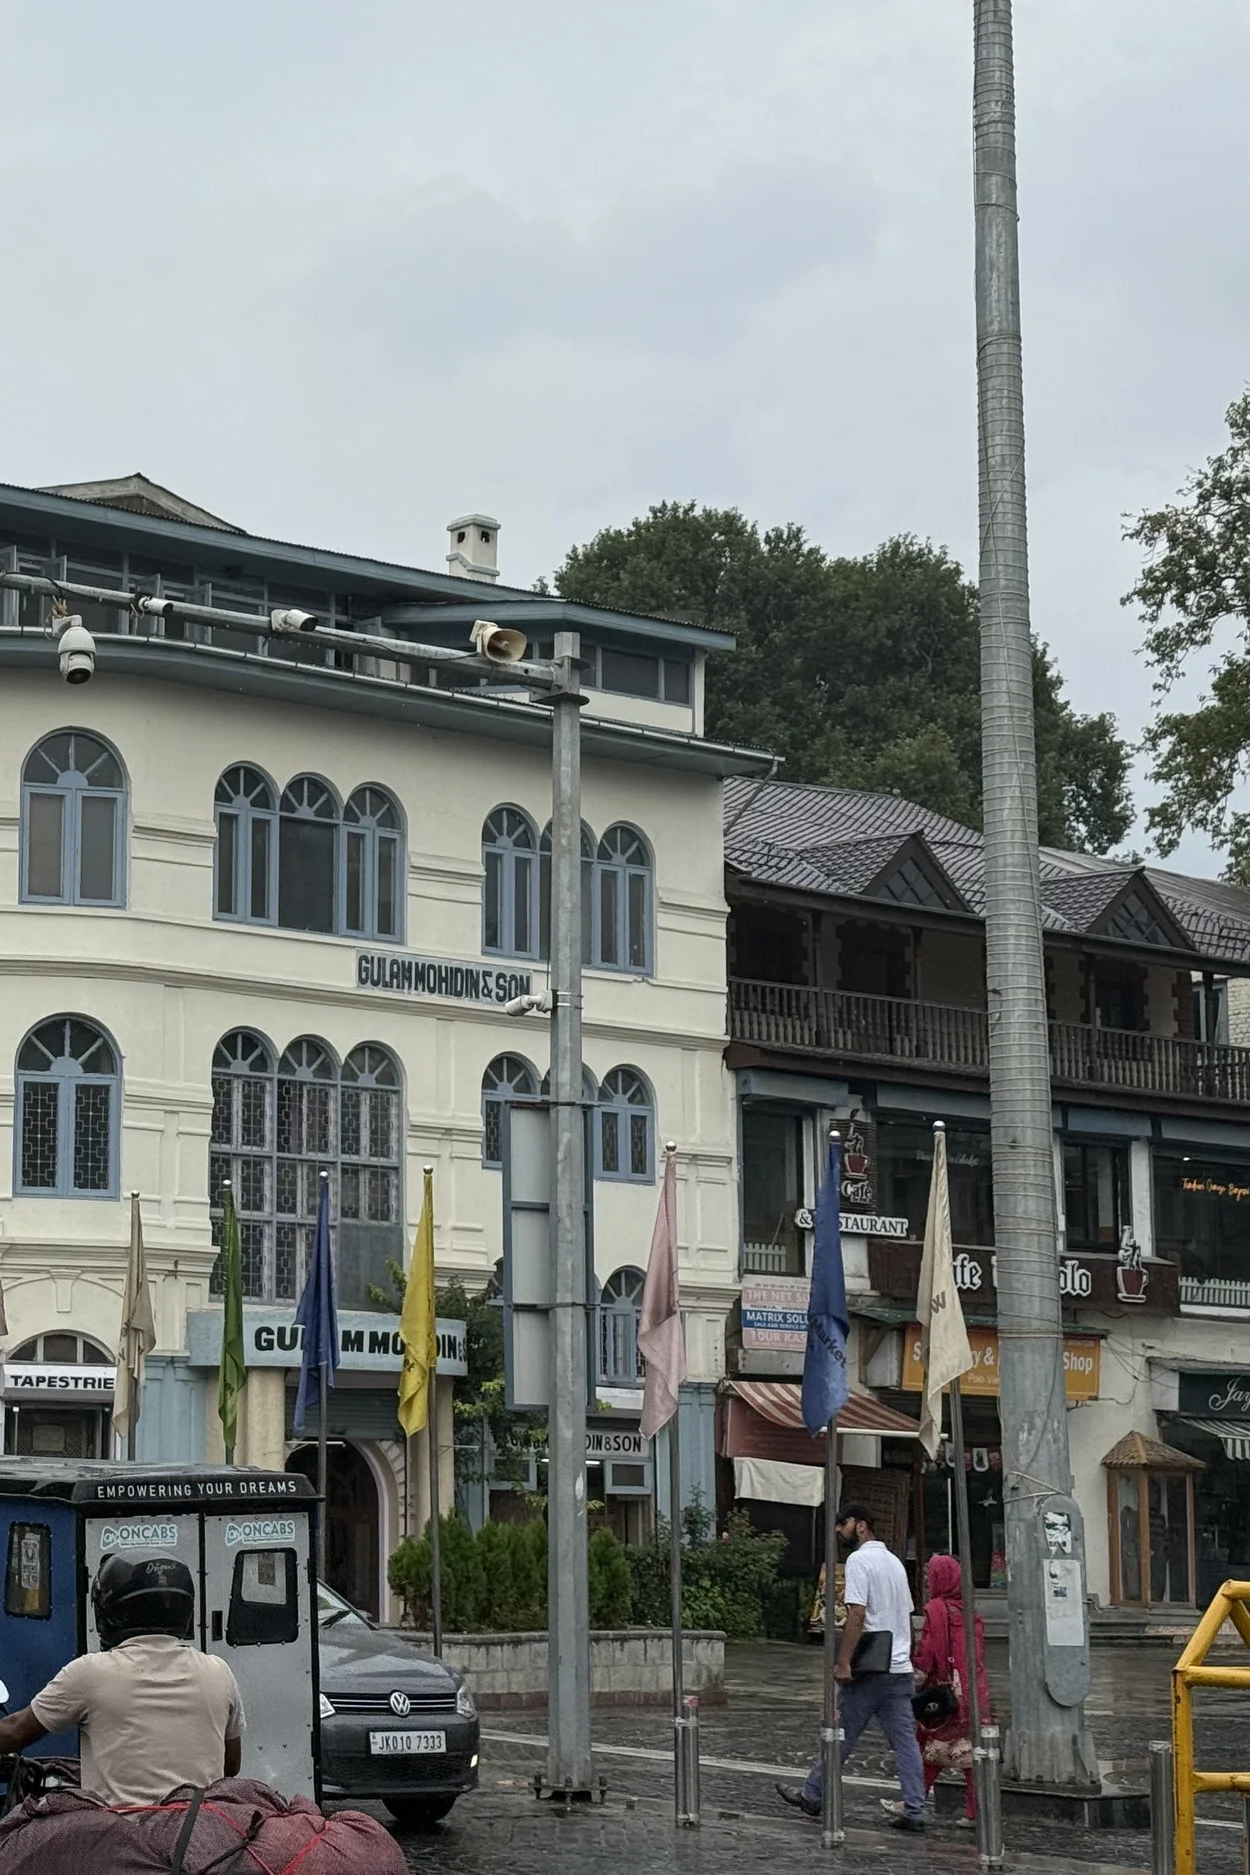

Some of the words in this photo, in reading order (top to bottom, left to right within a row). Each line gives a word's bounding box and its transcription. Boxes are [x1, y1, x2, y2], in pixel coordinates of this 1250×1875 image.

[358, 954, 412, 990] GULAM
[414, 961, 480, 999] MOHIDIN
[481, 971, 493, 998] &
[495, 971, 531, 1003] SON
[799, 1211, 811, 1226] &
[839, 1215, 907, 1235] STAURANT
[1059, 1260, 1092, 1297] olo
[746, 1290, 768, 1301] THE
[771, 1291, 792, 1302] NET
[747, 1311, 784, 1322] MATRIX
[254, 1326, 364, 1351] GUM
[750, 1330, 780, 1341] TOUR
[983, 1346, 994, 1365] &
[1062, 1352, 1093, 1373] Shop
[612, 1435, 641, 1452] SON
[97, 1484, 192, 1498] EMPOWERING
[197, 1482, 233, 1495] YOUR
[240, 1480, 297, 1494] DREAMS
[119, 1526, 176, 1540] ONCABS
[242, 1522, 295, 1536] ONCABS
[417, 1735, 442, 1750] 7333
